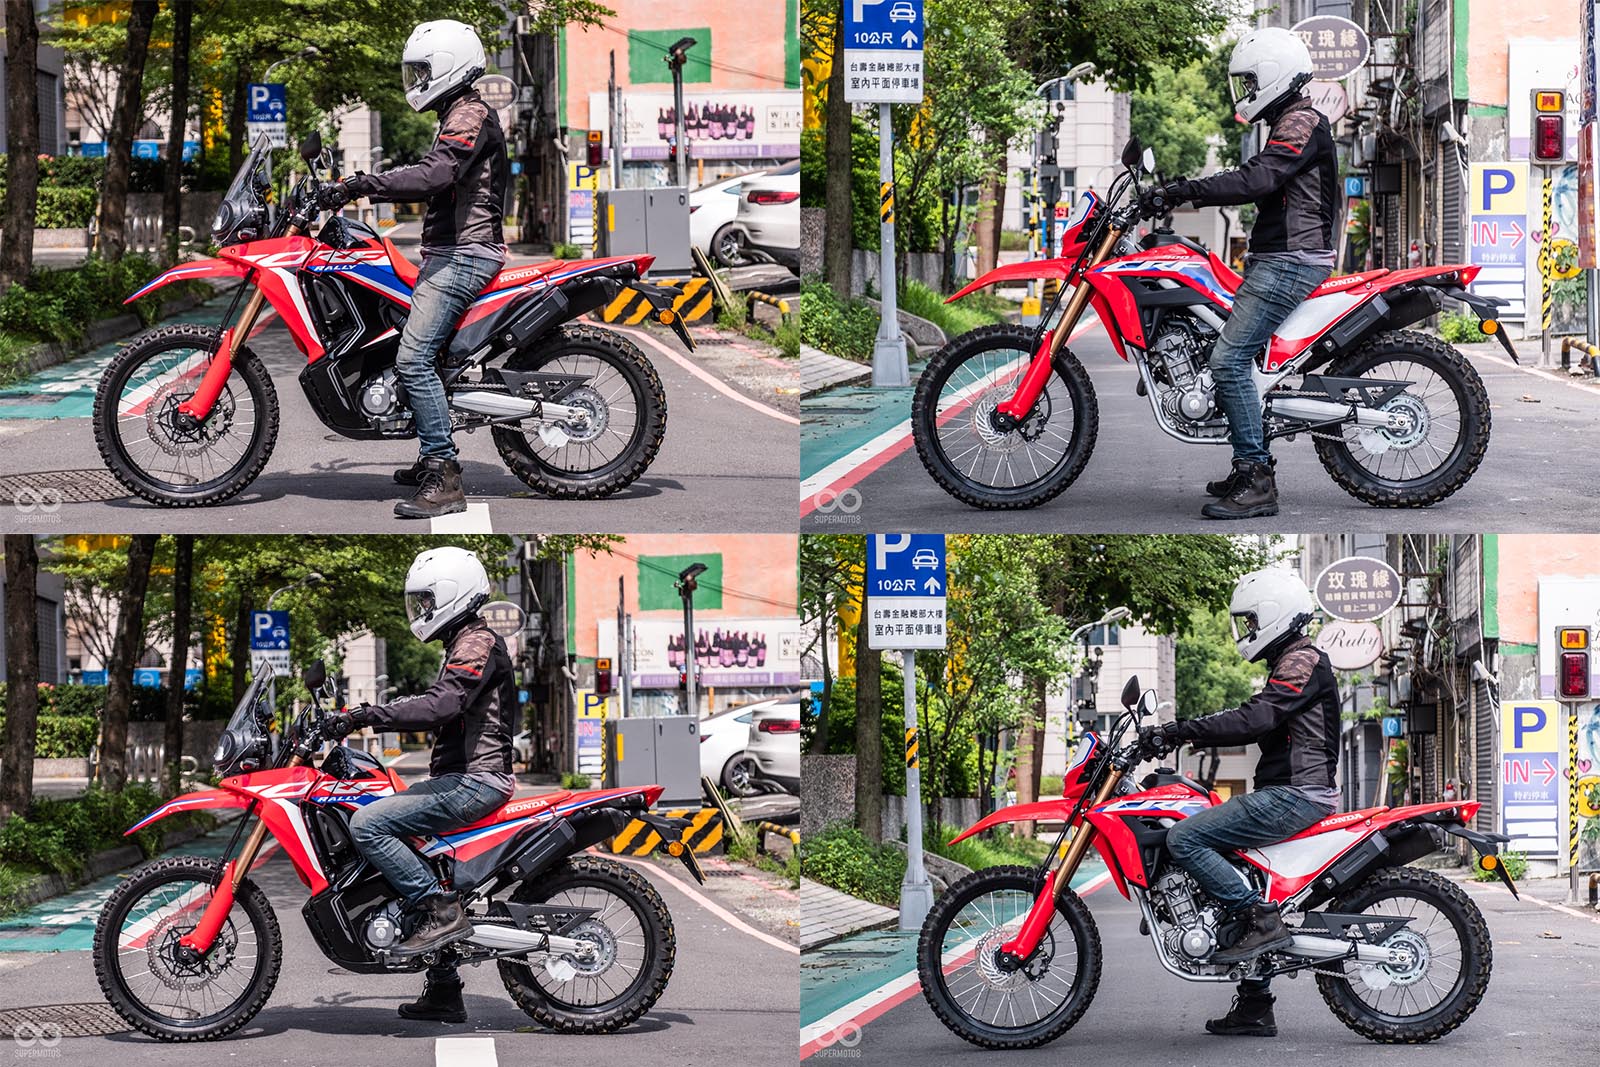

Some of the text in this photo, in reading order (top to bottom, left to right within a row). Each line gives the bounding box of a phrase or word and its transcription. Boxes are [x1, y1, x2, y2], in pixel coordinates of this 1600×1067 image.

[854, 32, 893, 44] 10公尺
[850, 62, 920, 72] 台壽金融總部大樓
[851, 77, 919, 89] 室內平面停車場
[252, 86, 270, 110] P
[576, 165, 594, 187] P
[1483, 169, 1515, 210] P
[1472, 221, 1498, 247] IN
[314, 264, 357, 272] RALLY
[499, 268, 542, 283] HONDA
[1321, 275, 1365, 290] HONDA
[877, 579, 916, 591] 10公尺
[1327, 569, 1390, 590] 玫瑰緣
[874, 609, 943, 619] 台壽金融總部大樓
[254, 613, 273, 637] P
[875, 624, 942, 636] 室內平面停車場
[1321, 628, 1379, 655] Ruby
[584, 693, 604, 716] P
[1514, 707, 1547, 749] P
[1504, 760, 1530, 784] IN
[318, 795, 360, 803] RALLY
[505, 800, 549, 814] HONDA
[1321, 813, 1364, 827] HONDA
